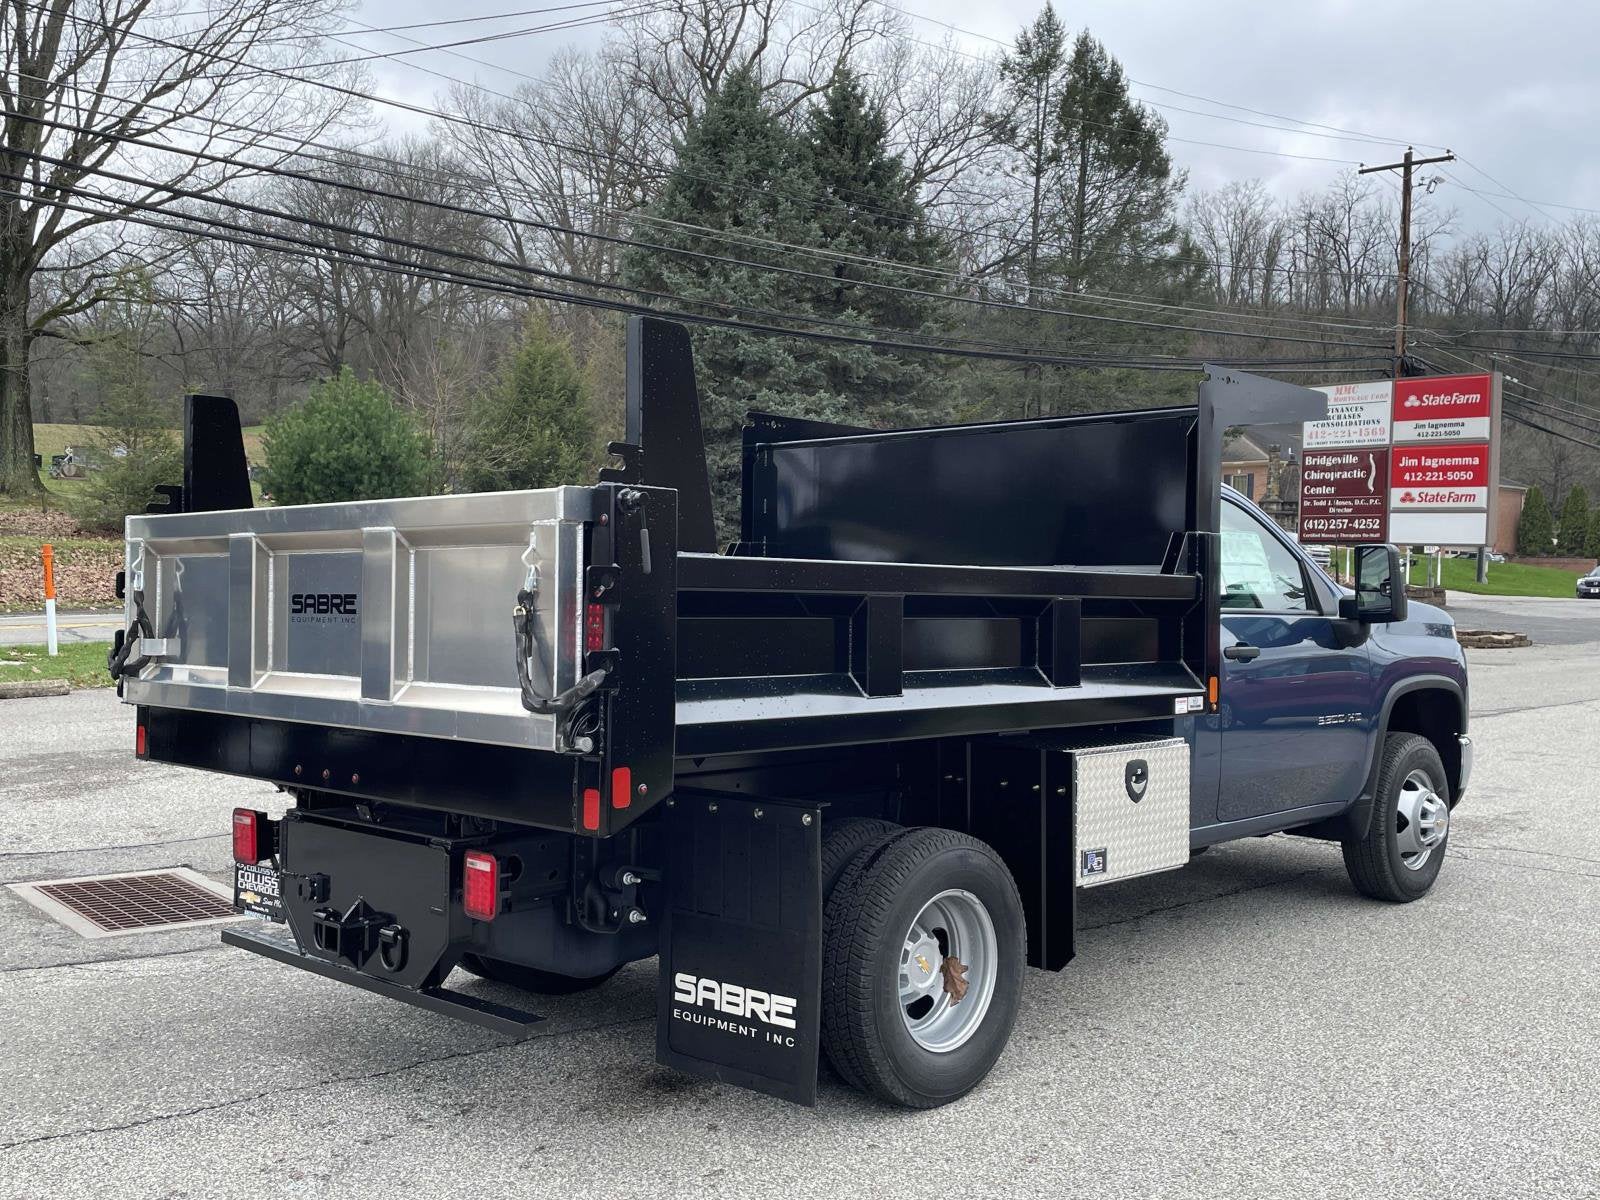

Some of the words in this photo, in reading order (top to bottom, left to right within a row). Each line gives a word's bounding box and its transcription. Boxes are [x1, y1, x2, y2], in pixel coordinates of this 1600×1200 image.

[1428, 421, 1465, 429] Iagnemma
[1416, 430, 1461, 438] 412-221-5050
[1305, 453, 1359, 467] Bridgeville
[1398, 456, 1418, 467] Jim
[1421, 455, 1480, 468] Iagnemma
[1304, 468, 1367, 481] Chiropractic
[1403, 471, 1474, 481] 412-221-5050
[1304, 485, 1336, 495] Center
[291, 593, 357, 614] SABRE
[291, 616, 337, 624] EQUIPMENT
[238, 870, 280, 889] COLUSS
[237, 880, 280, 897] CHEVROLE
[674, 972, 797, 1029] SABRE
[673, 1008, 758, 1038] EQUIPMENT
[766, 1032, 795, 1047] INC
